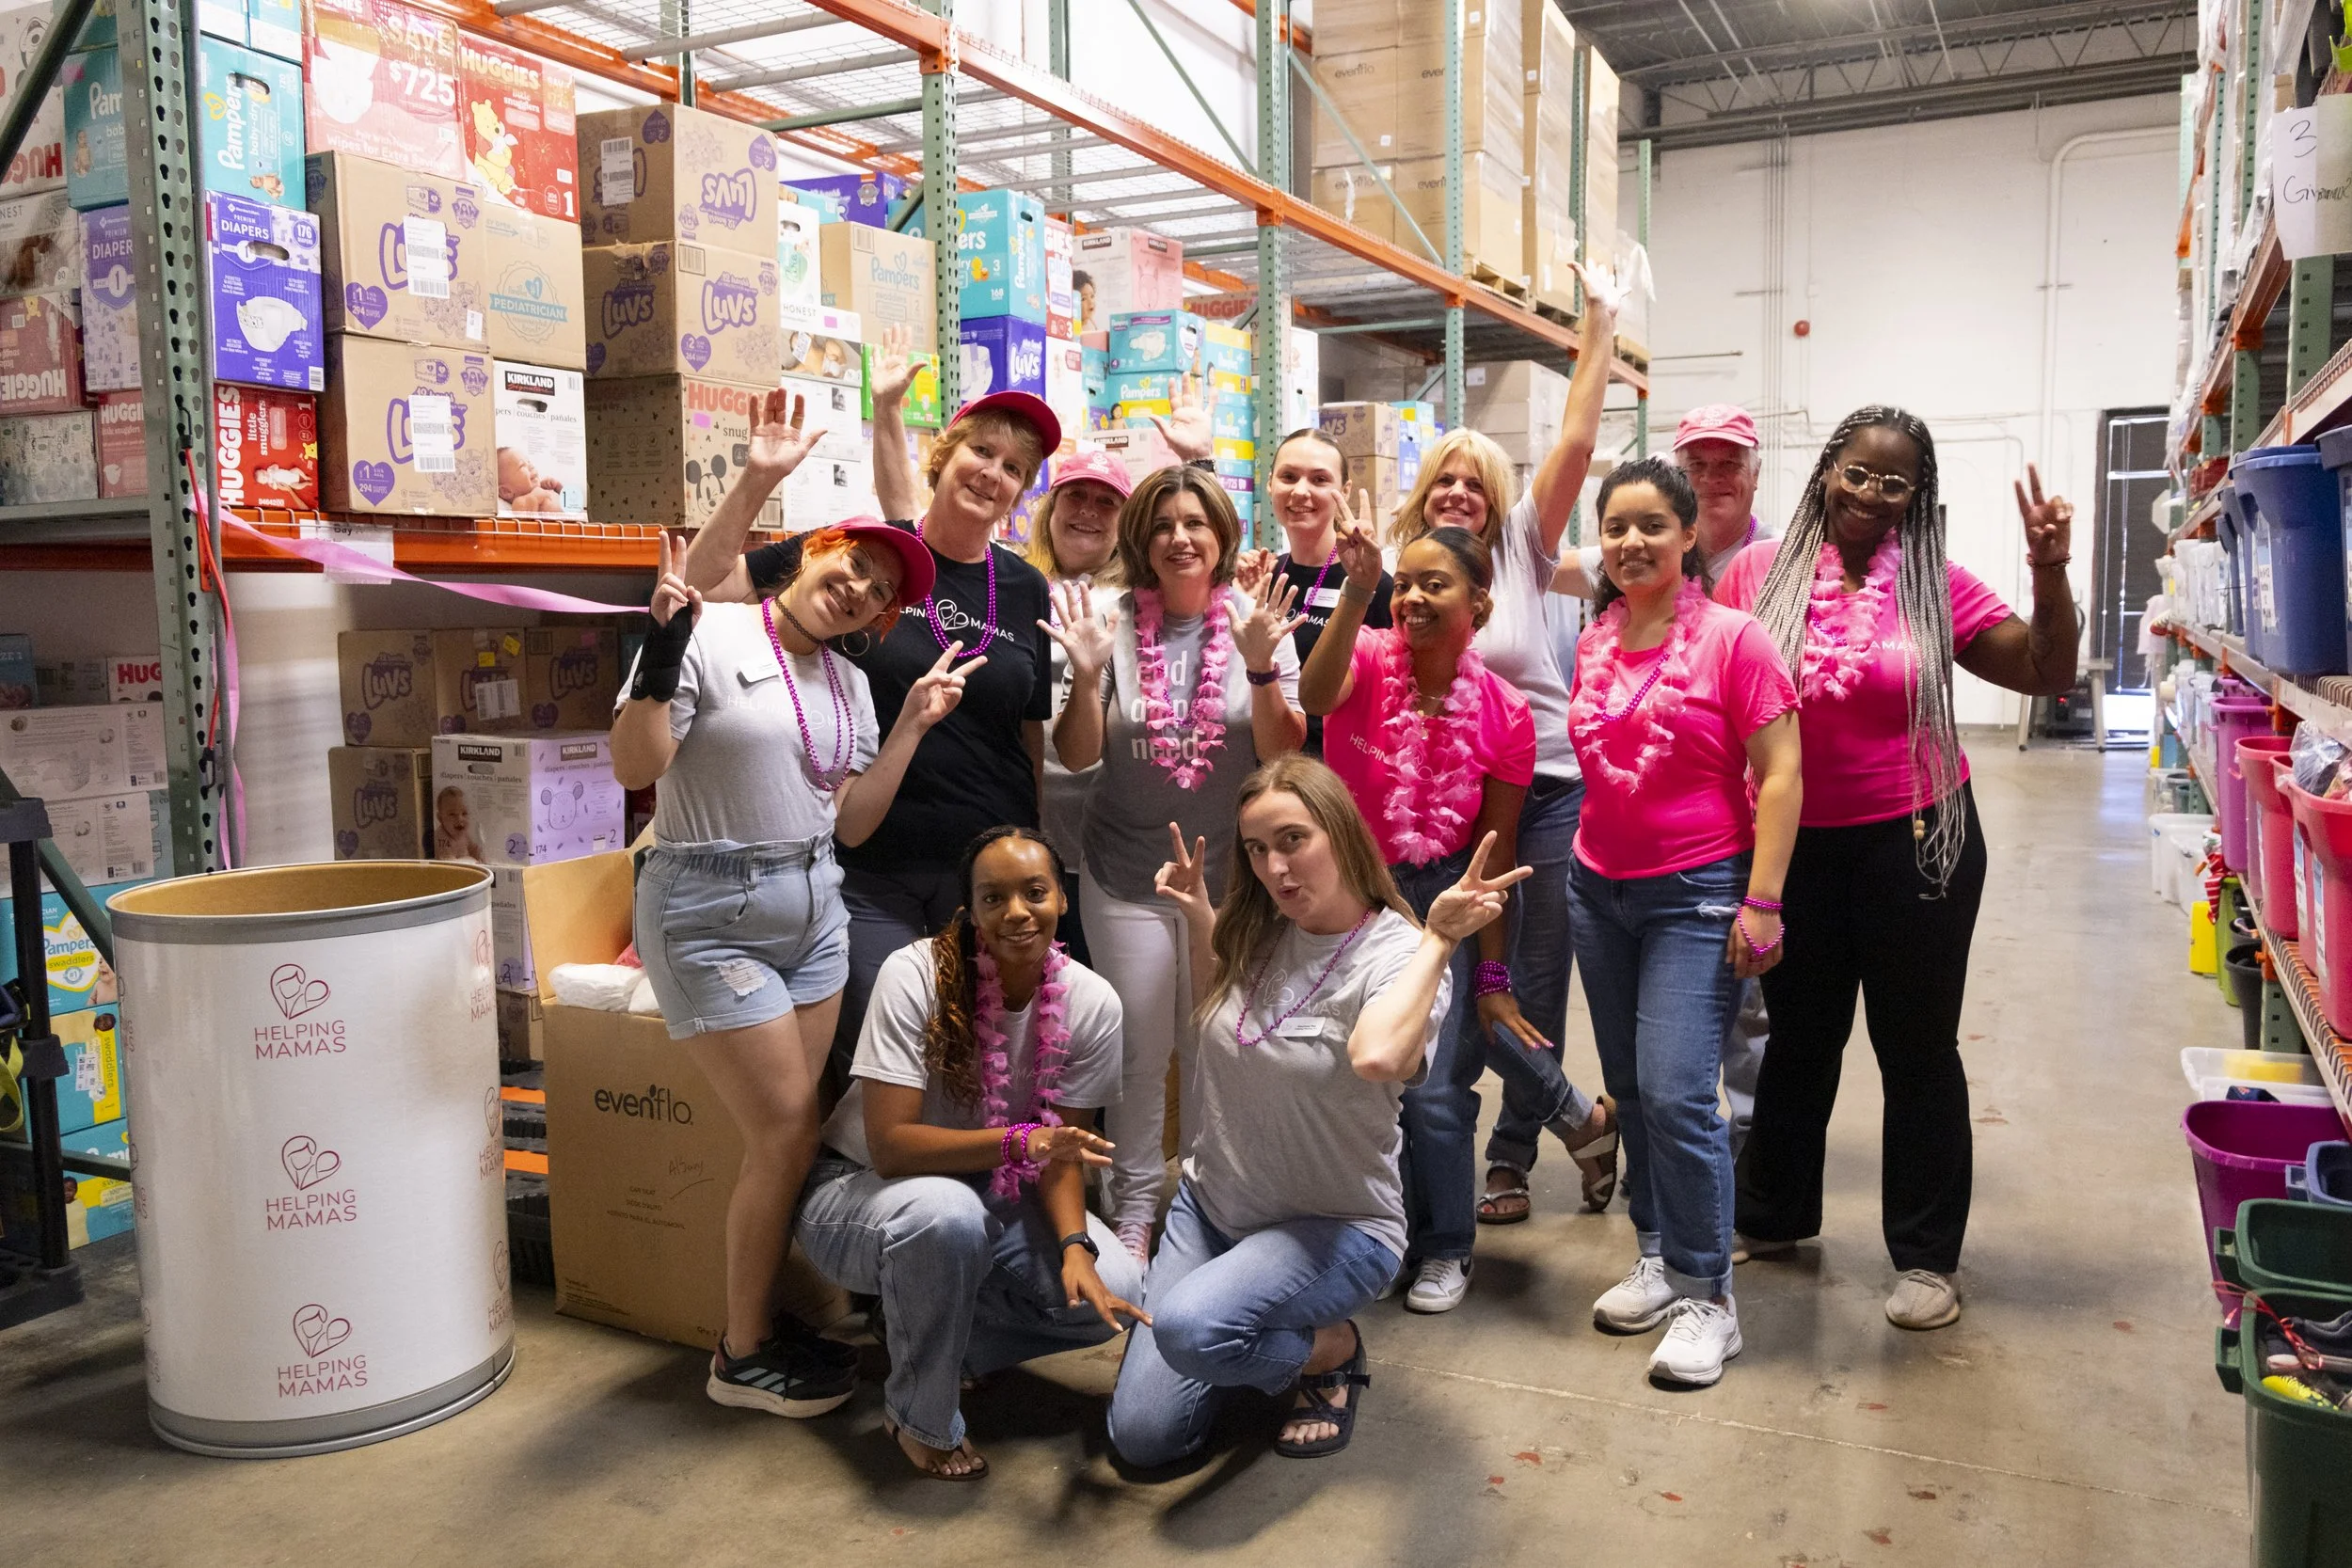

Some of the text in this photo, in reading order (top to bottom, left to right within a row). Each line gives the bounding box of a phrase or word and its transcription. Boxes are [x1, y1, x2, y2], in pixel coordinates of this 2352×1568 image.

[461, 45, 542, 90] HUGGIES
[389, 58, 456, 107] $725
[2289, 119, 2318, 159] 3
[220, 219, 270, 240] DIAPERS
[295, 223, 313, 239] 176
[91, 239, 135, 260] DIAPER
[870, 255, 921, 291] Pampers
[493, 297, 564, 320] PEDIATRICIAN
[602, 291, 655, 339] Luvs
[702, 281, 756, 333] Luvs
[783, 304, 817, 317] HONEST
[1009, 346, 1041, 386] Luvs
[506, 372, 554, 388] KIRKLAND
[1120, 383, 1162, 401] Pampers
[246, 412, 258, 442] little
[259, 399, 268, 457] snugglers
[549, 412, 578, 424] pañales
[217, 386, 246, 506] HUGGIES
[723, 425, 749, 442] snug
[333, 523, 354, 537] Bay
[362, 660, 413, 710] Luvs
[459, 746, 501, 757] KIRKLAND
[562, 745, 596, 755] KIRKLAND
[1348, 731, 1389, 764] HELPIN
[354, 786, 399, 830] Luvs
[507, 839, 516, 855] 2
[609, 828, 617, 844] 2
[534, 844, 548, 855] 174
[48, 953, 95, 970] swaddlers
[253, 1019, 346, 1042] HELPING
[254, 1036, 347, 1061] MAMAS
[103, 1037, 114, 1089] swaddlers
[265, 1188, 358, 1214] HELPING
[266, 1204, 358, 1232] MAMAS
[277, 1354, 368, 1381] HELPING
[278, 1370, 369, 1400] MAMAS
